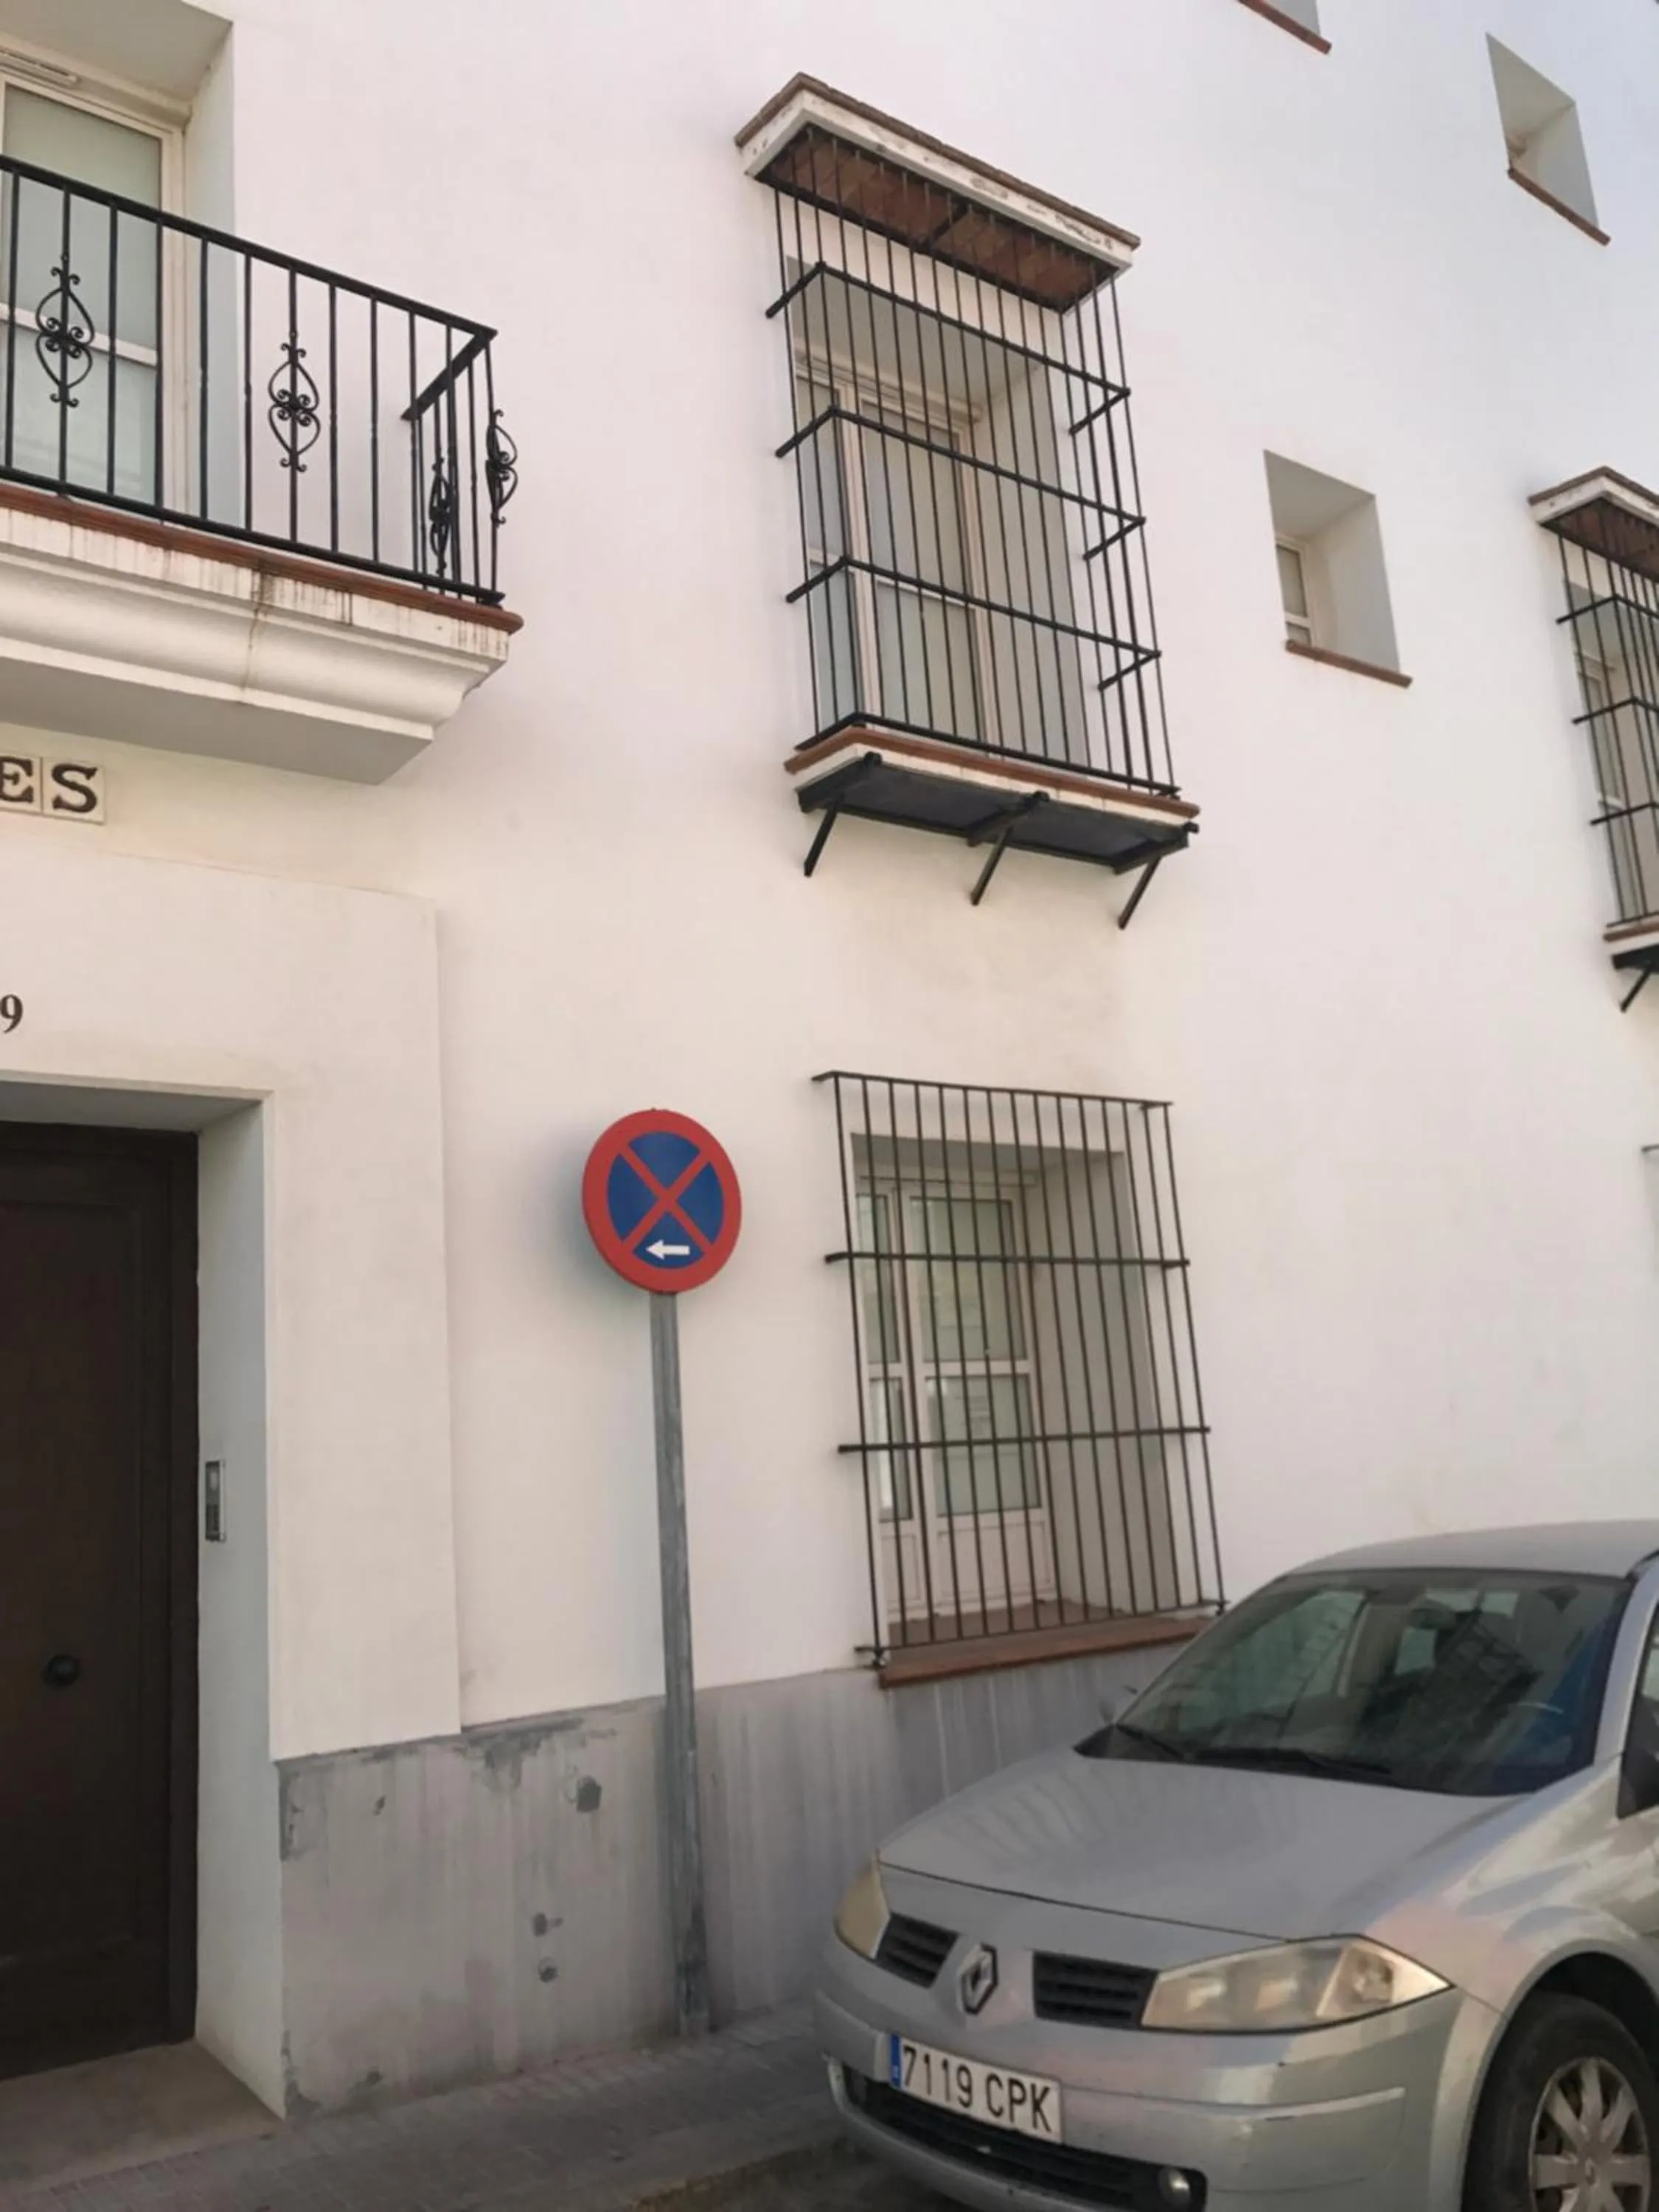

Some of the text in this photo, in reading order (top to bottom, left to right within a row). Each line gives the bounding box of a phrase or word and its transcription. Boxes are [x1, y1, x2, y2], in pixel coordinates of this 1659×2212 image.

[0, 757, 98, 813] ES
[0, 994, 23, 1033] 9
[902, 2046, 1051, 2132] 7119 CPK
